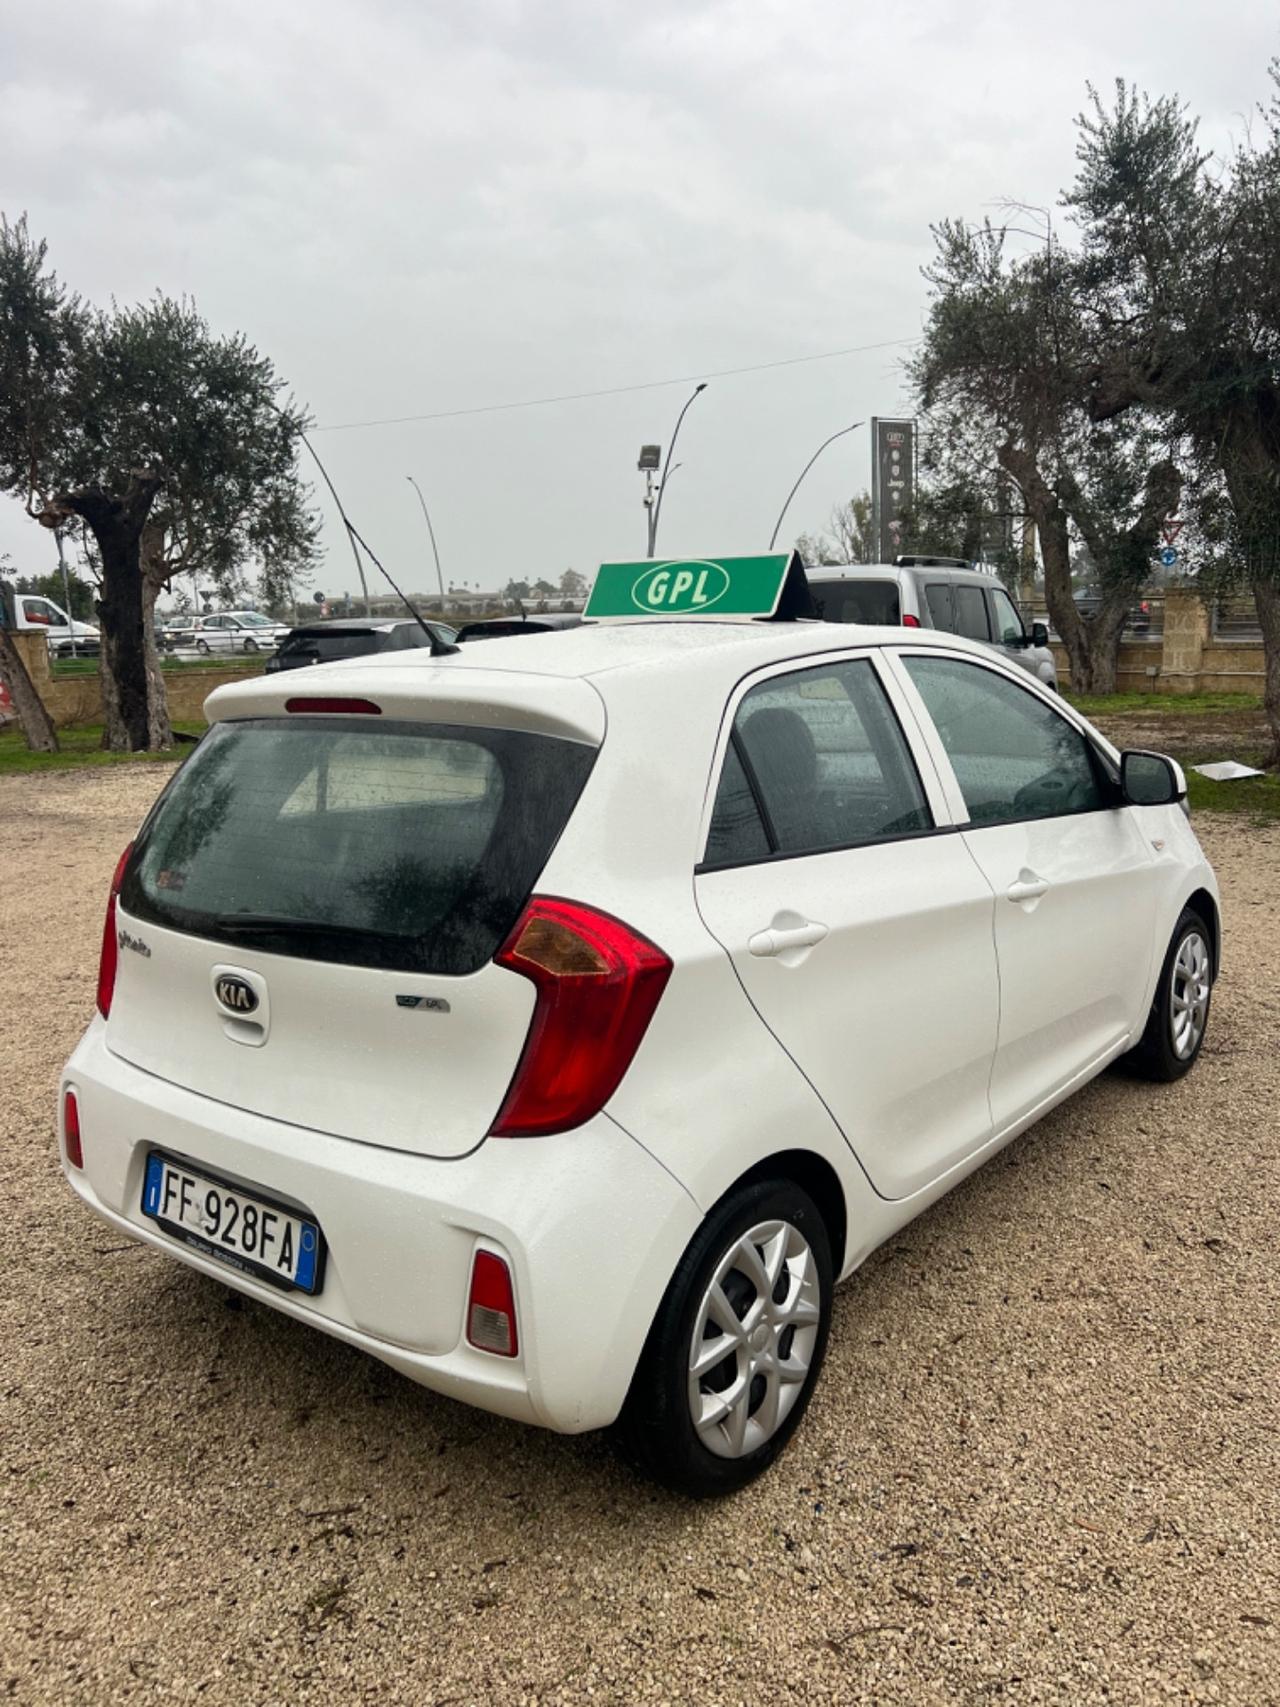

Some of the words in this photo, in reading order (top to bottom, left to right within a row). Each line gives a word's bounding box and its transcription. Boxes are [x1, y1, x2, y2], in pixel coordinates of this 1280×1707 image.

[647, 569, 709, 605] GPL
[219, 981, 250, 1009] KIA
[162, 1169, 196, 1221] FF
[204, 1190, 293, 1273] 928FA
